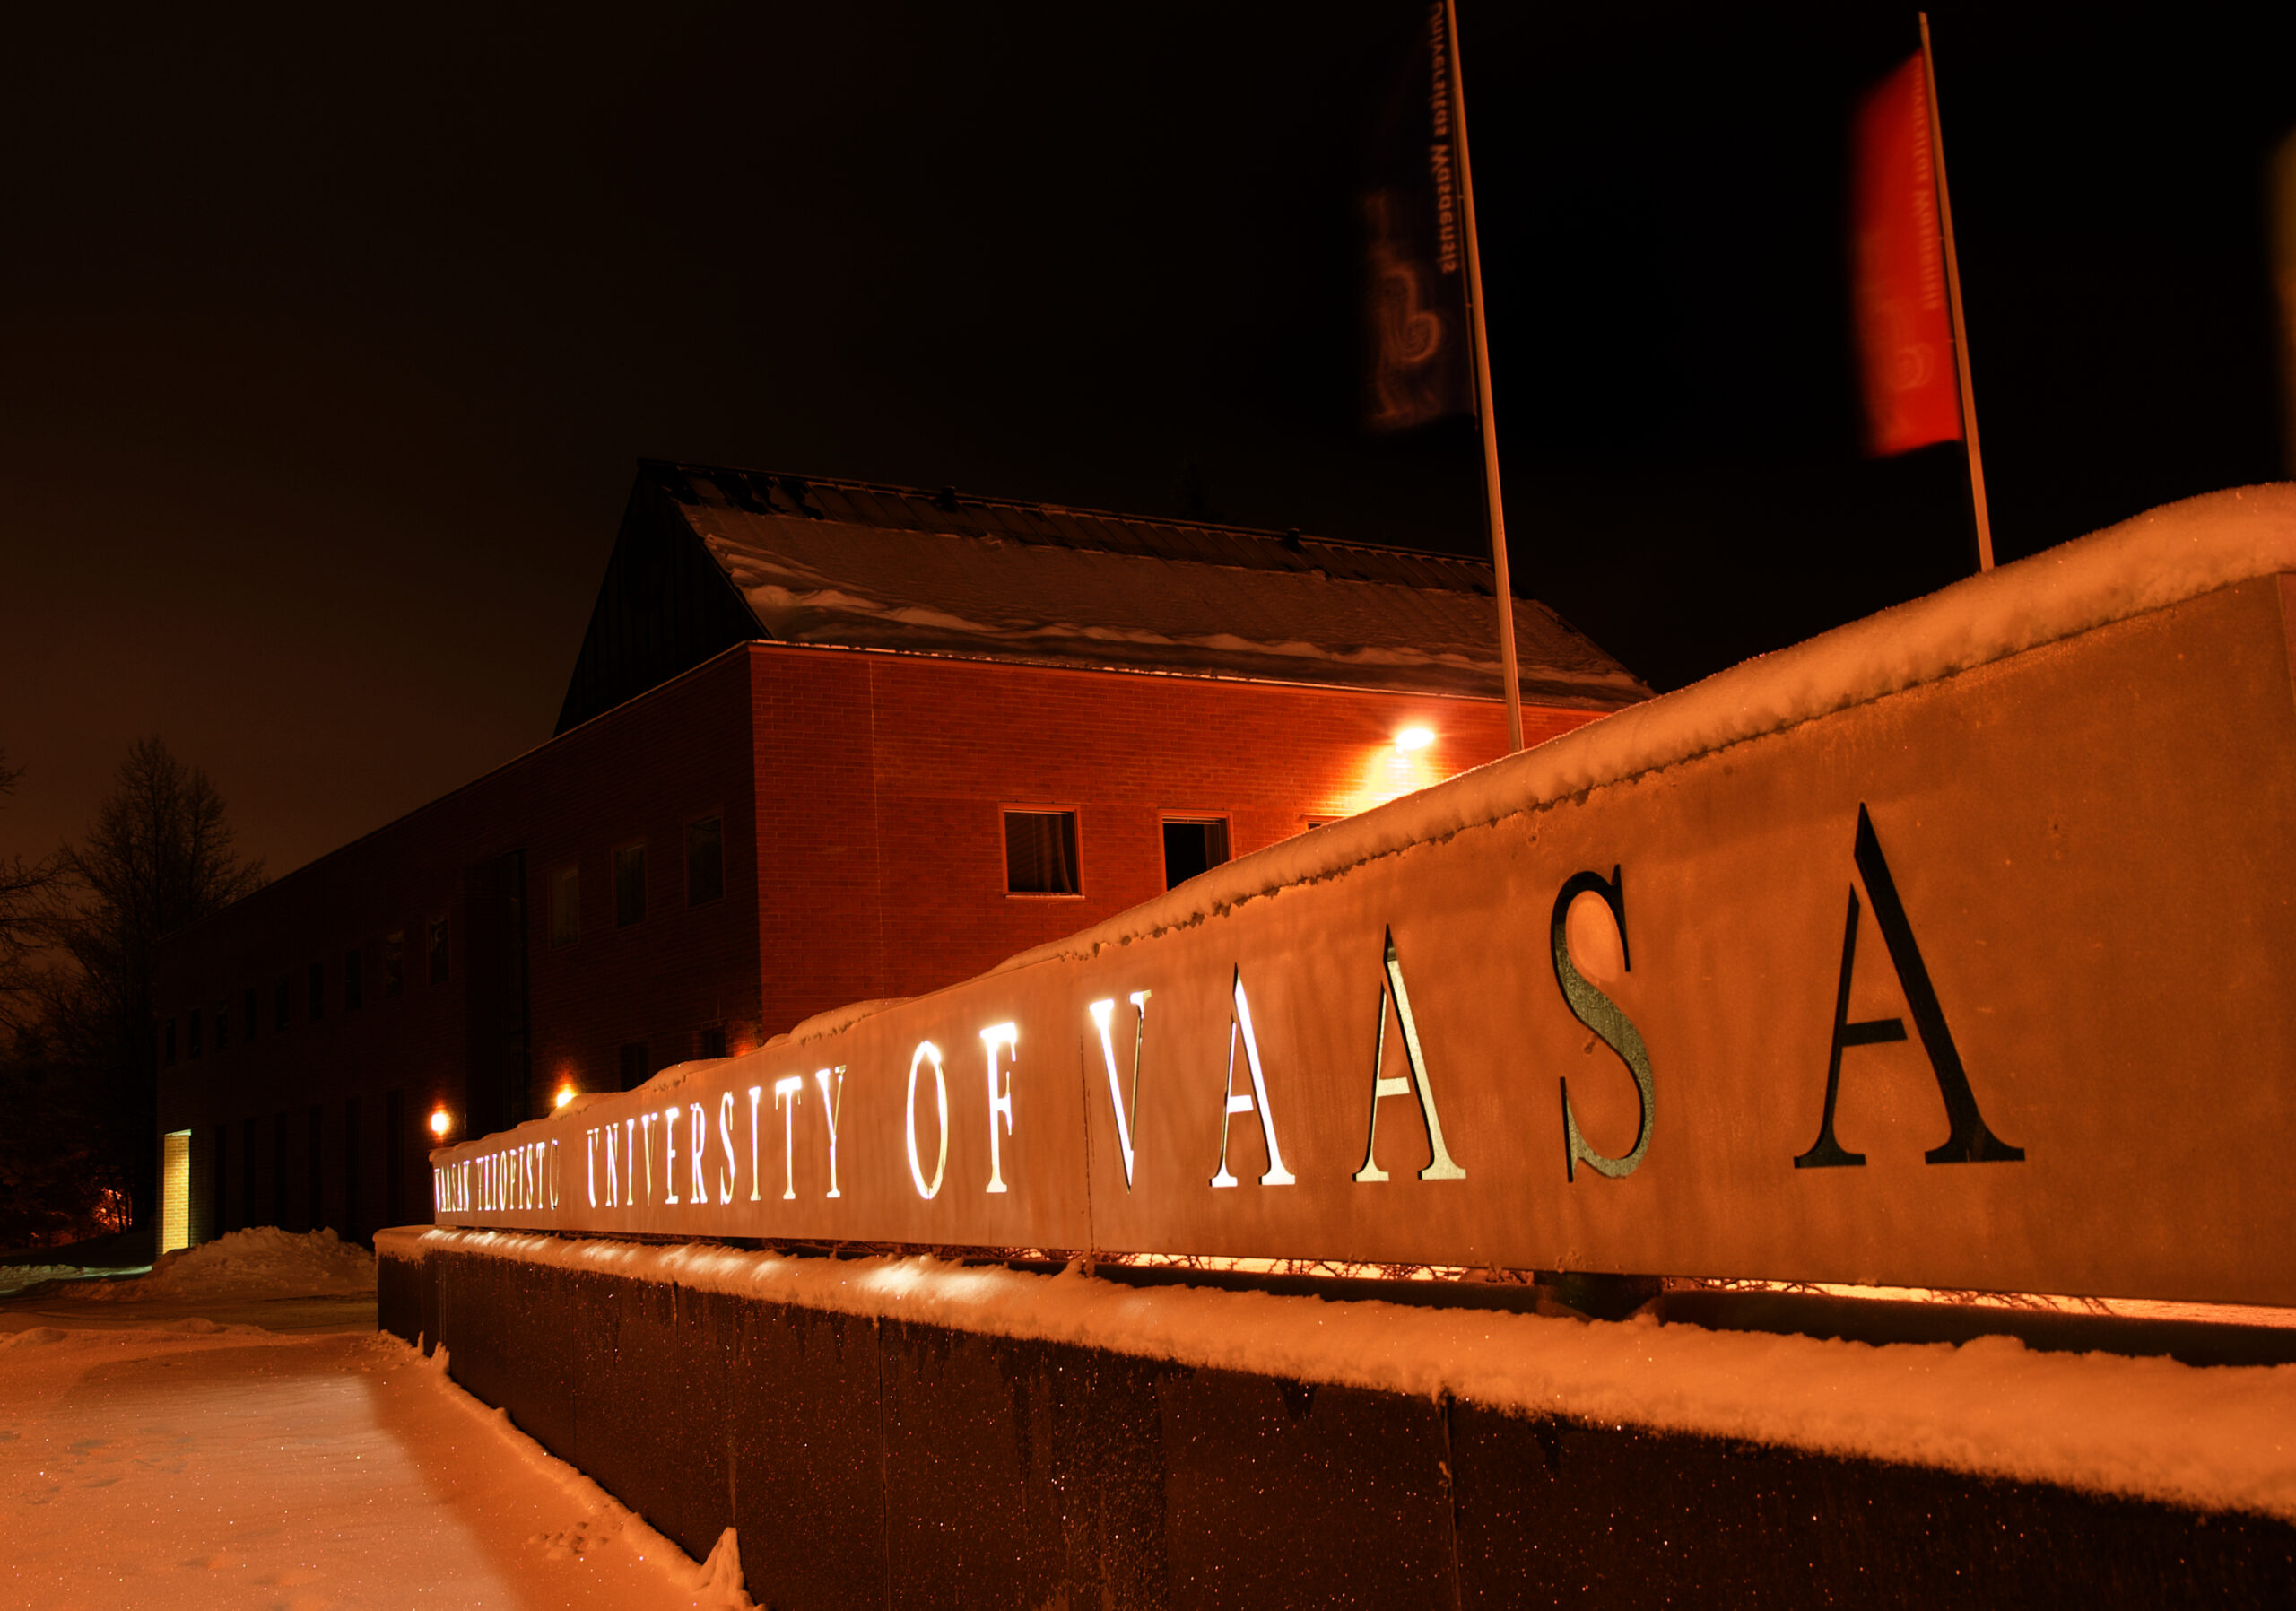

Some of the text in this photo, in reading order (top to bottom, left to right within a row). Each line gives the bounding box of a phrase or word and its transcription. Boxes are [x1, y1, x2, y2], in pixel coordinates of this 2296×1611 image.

[434, 802, 2025, 1213] VAASAN YLIOPISTO UNIVERSITY OF VAASA
